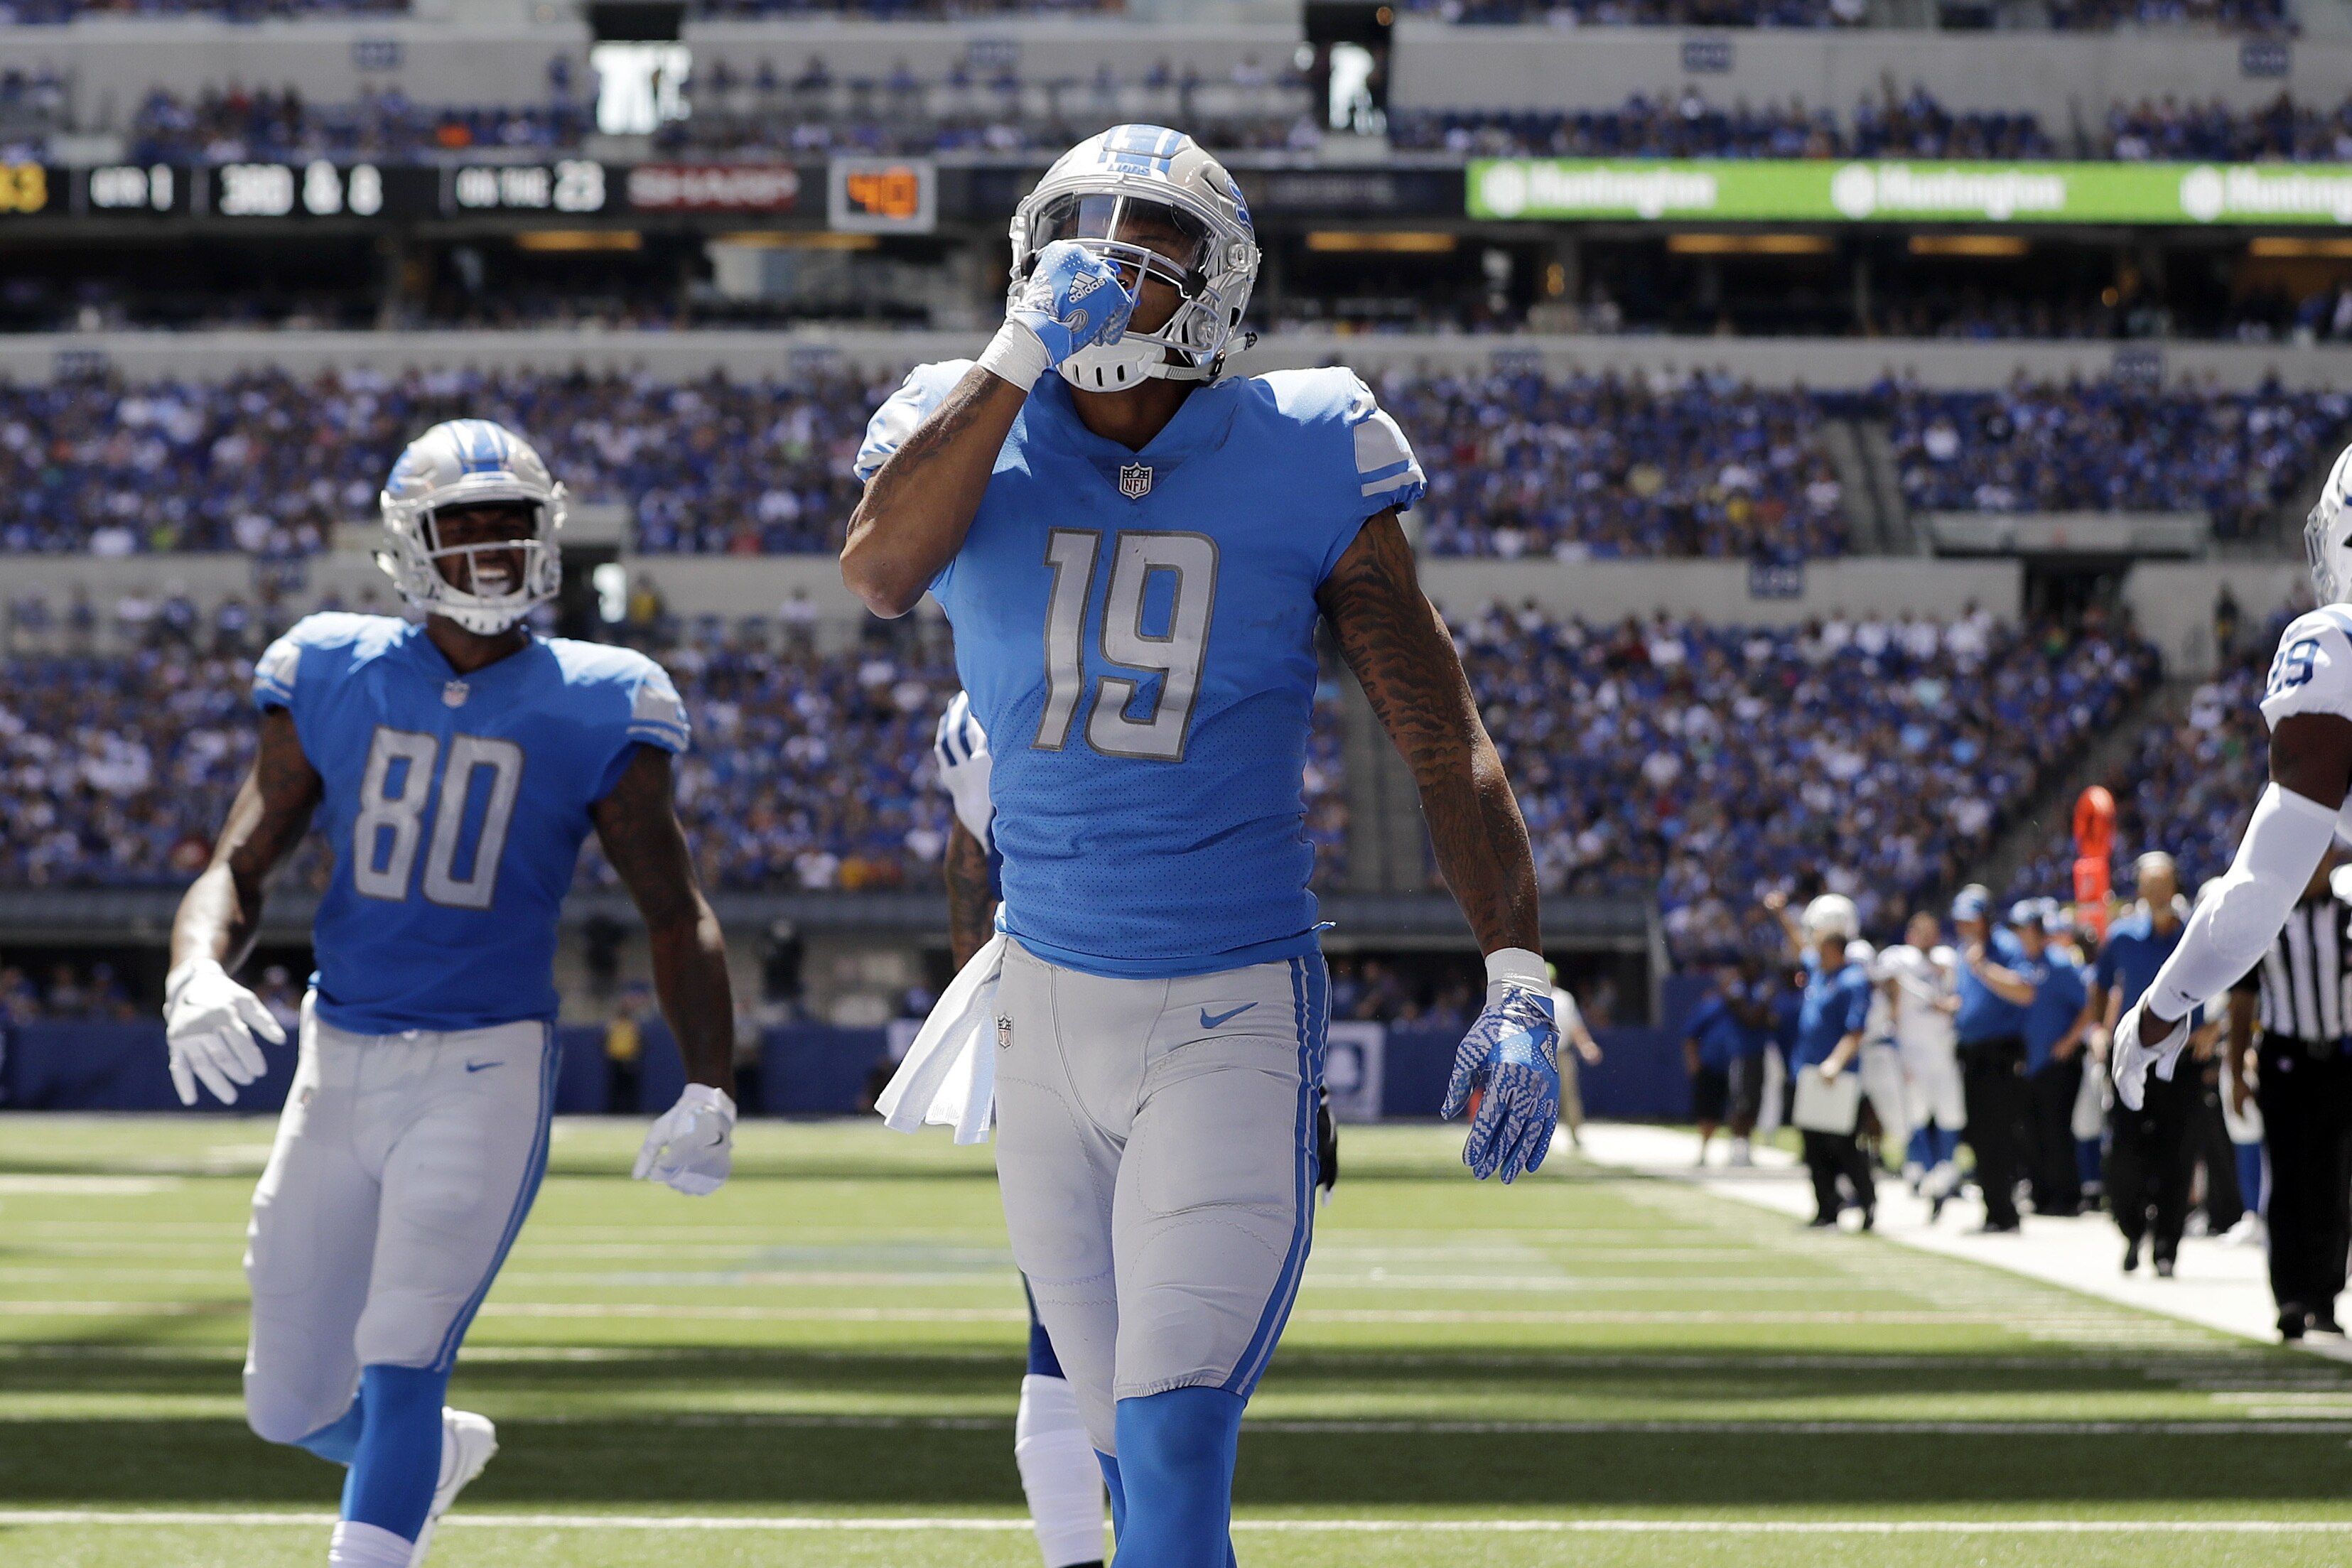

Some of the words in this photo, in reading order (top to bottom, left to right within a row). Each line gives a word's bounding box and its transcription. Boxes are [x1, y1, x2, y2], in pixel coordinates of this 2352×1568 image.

[848, 167, 917, 218] 40
[1528, 162, 1717, 218] Huntington
[1877, 163, 2066, 220] Huntington
[1069, 277, 1106, 303] adidas
[1125, 479, 1146, 492] NFL
[1030, 526, 1219, 763] 19
[353, 723, 526, 912] 80
